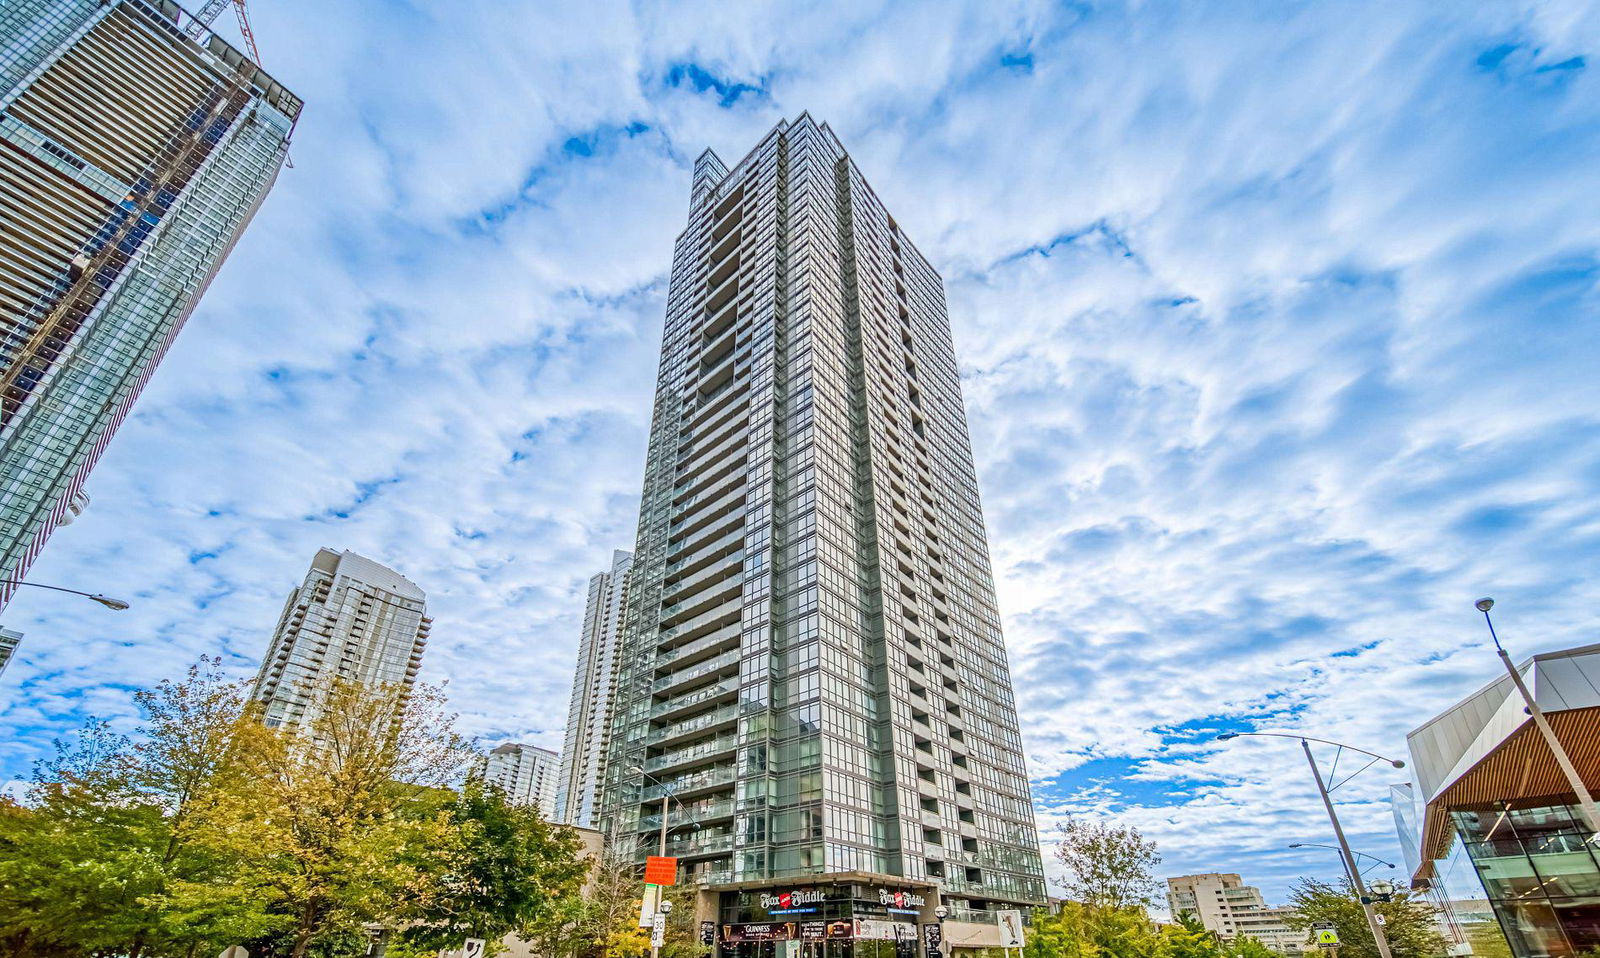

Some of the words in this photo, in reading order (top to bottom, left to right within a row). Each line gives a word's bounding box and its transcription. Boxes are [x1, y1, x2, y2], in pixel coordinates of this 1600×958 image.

[760, 893, 780, 909] Fox
[791, 891, 825, 906] Fiddle
[879, 888, 895, 905] Fox
[902, 892, 925, 907] Fiddle
[655, 921, 663, 929] 30
[745, 924, 770, 933] GUINNESS
